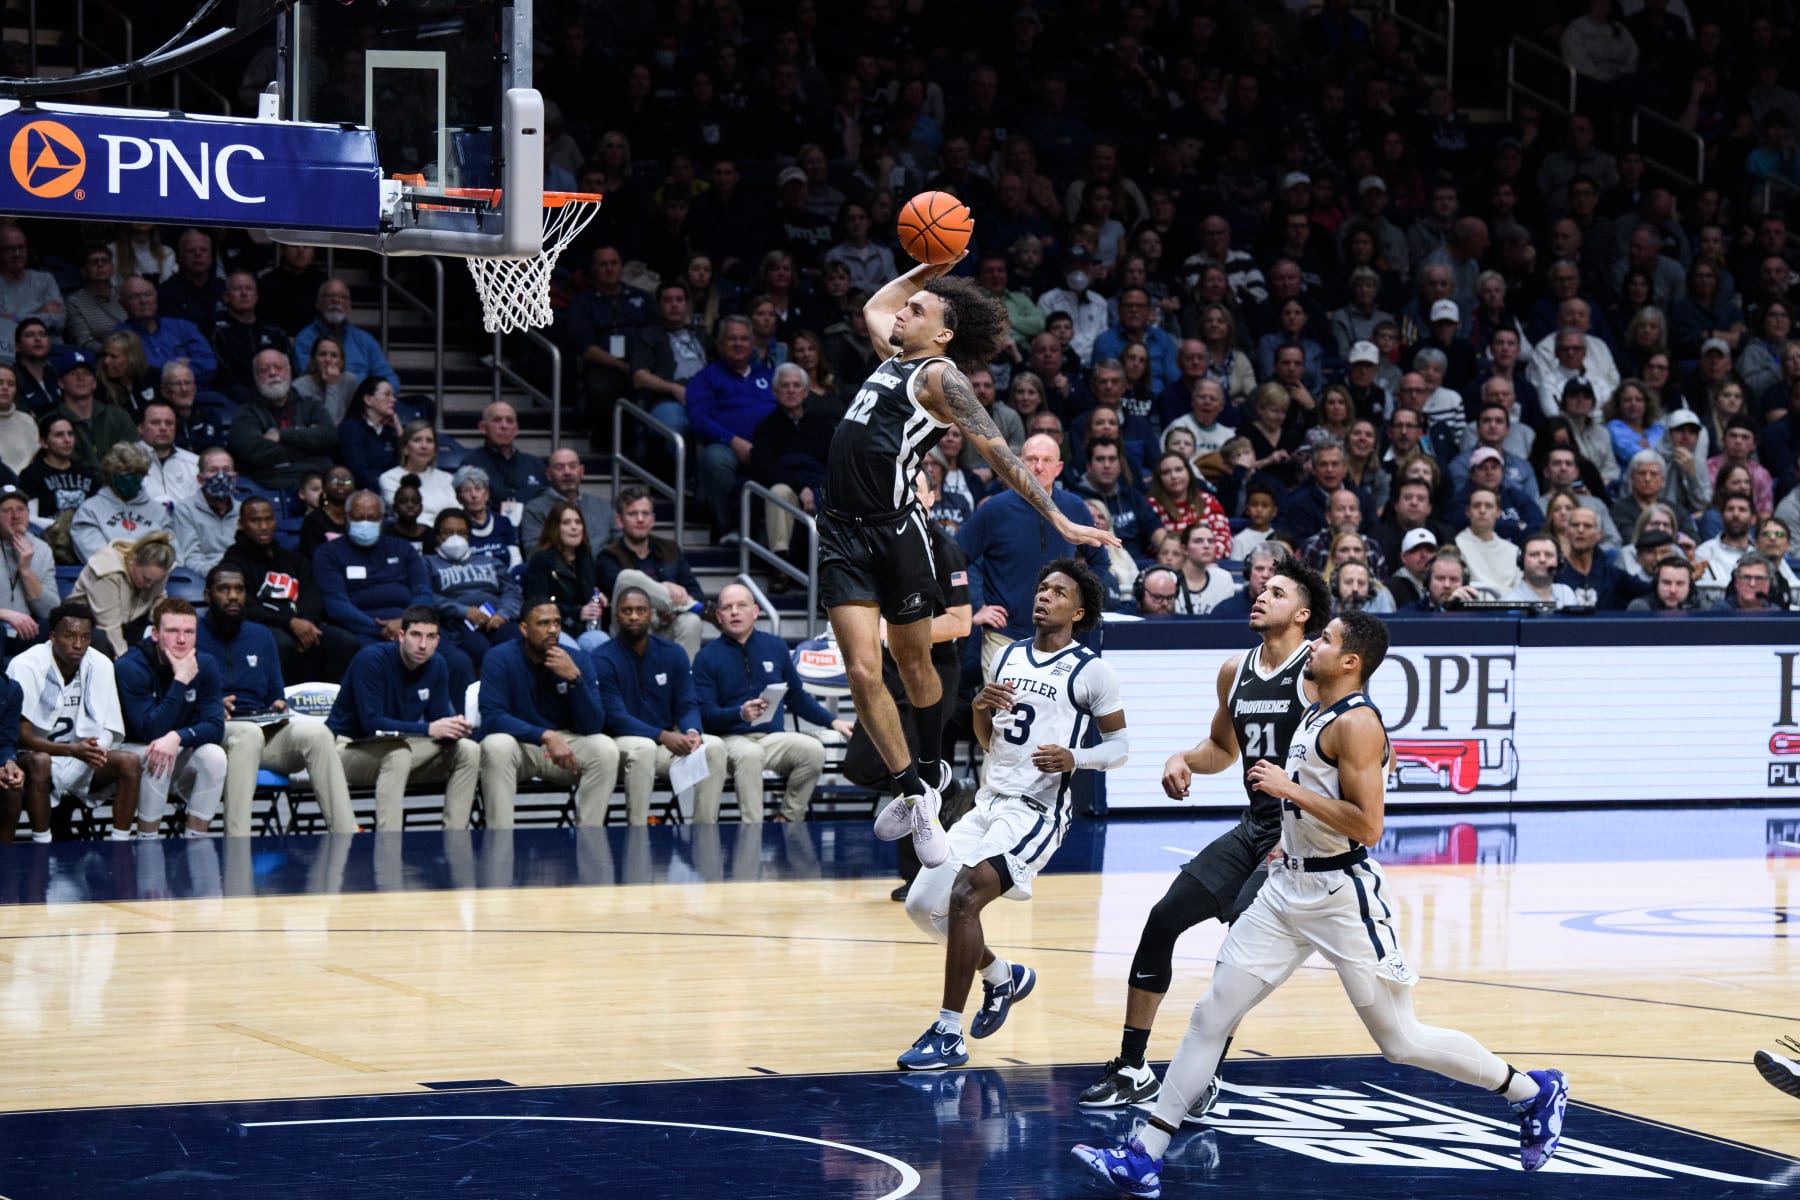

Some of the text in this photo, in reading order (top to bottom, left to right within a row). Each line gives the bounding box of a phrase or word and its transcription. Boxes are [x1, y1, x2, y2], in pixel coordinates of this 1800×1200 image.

[98, 134, 266, 204] PNC
[844, 388, 879, 426] 22
[44, 473, 92, 492] BUTLER
[106, 510, 152, 527] BUTLER
[438, 563, 499, 591] BUTLER
[1234, 698, 1291, 718] PROVIDENCE
[1362, 654, 1516, 732] OPE
[48, 717, 74, 744] 2
[1004, 702, 1035, 746] 3
[1244, 722, 1279, 758] 21
